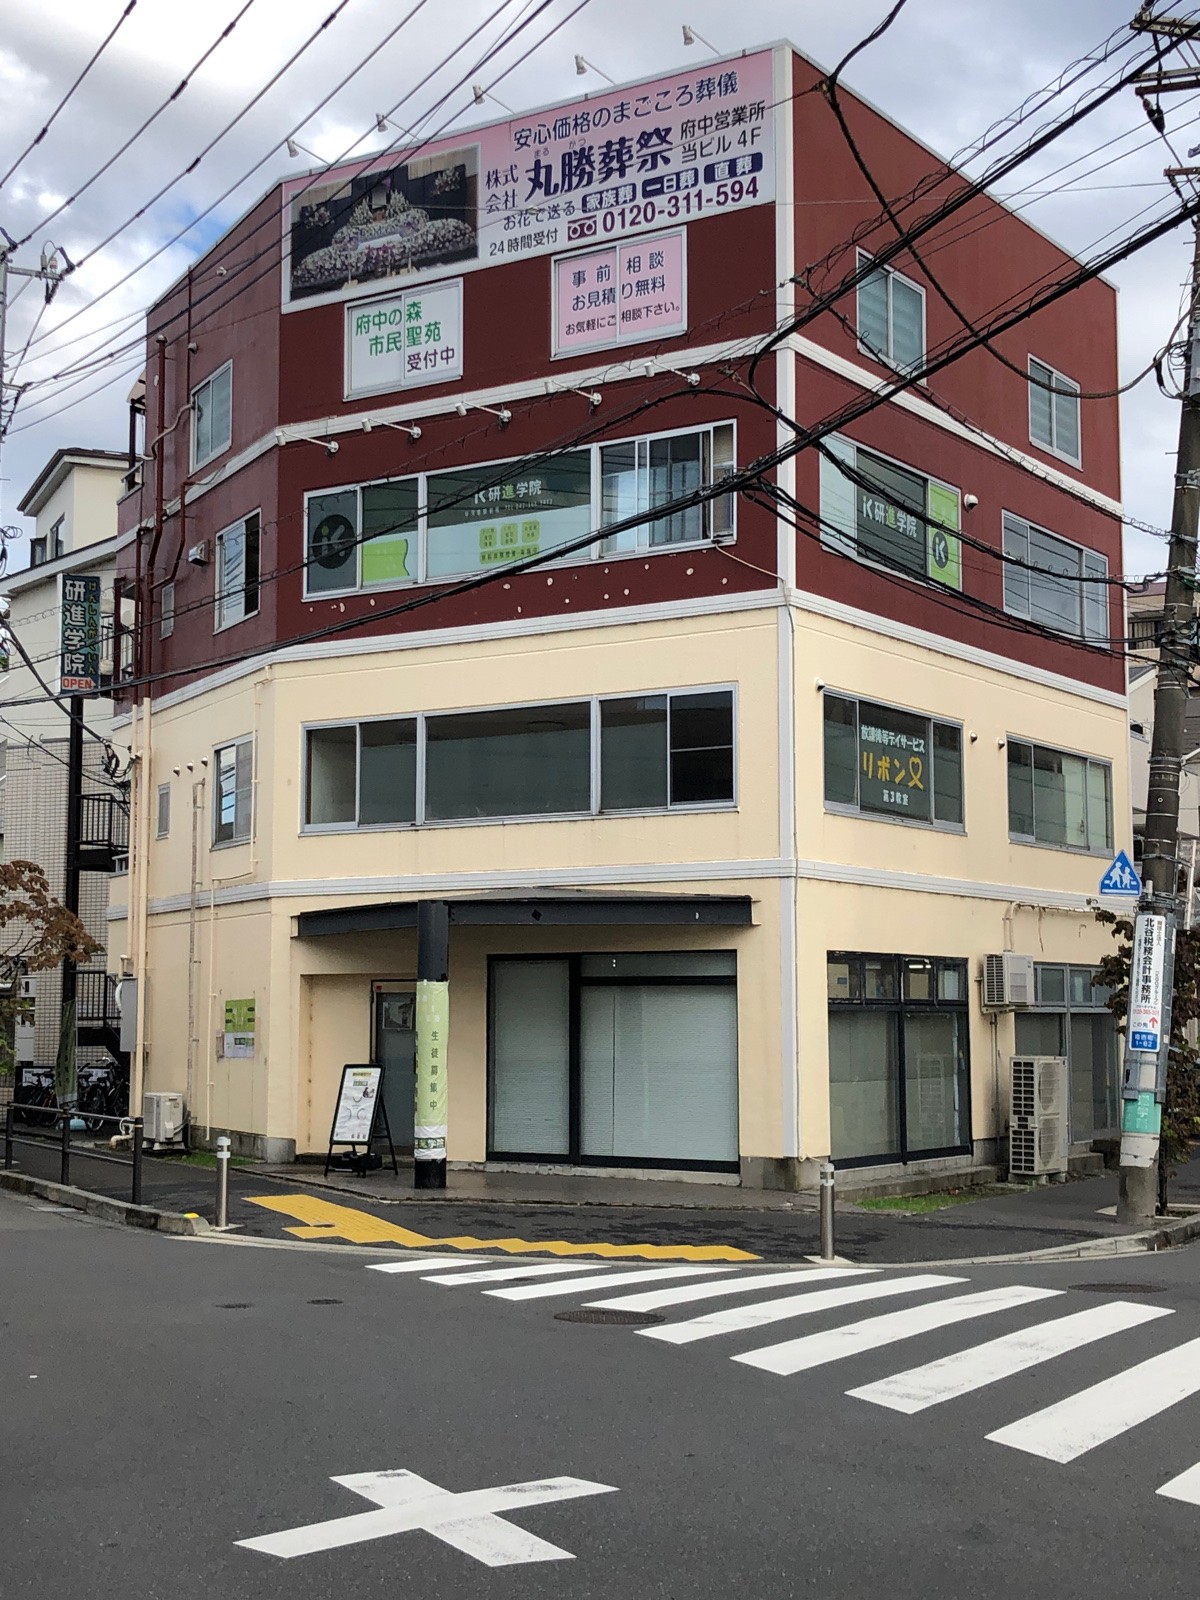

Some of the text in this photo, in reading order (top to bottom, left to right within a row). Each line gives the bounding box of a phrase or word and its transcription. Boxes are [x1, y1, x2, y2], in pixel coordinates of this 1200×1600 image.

[514, 71, 738, 152] 安心価格のまごころ葬儀
[680, 100, 766, 141] 府中営業所
[681, 126, 762, 164] 当ビル 4F
[486, 164, 519, 190] 株式
[524, 127, 673, 202] 丸勝葬祭
[486, 189, 518, 214] 会社
[503, 155, 752, 232] お花で送る 家族葬 一日葬 直葬
[602, 175, 759, 234] 0120-311-594
[490, 227, 558, 257] 24時間受付
[572, 251, 664, 289] 事前相談
[572, 274, 666, 312] お見積り無料
[355, 301, 422, 336] 府中の森
[369, 321, 442, 357] 市民聖苑
[407, 346, 455, 373] 受付中
[64, 580, 86, 675] 研進学院
[88, 581, 97, 675] けんしんがくいん
[62, 678, 93, 689] OPEN
[861, 724, 925, 754] 放課後等デイサービス
[863, 751, 906, 785] リボン
[1141, 917, 1154, 1004] 北谷税務会計事務所
[430, 1031, 440, 1111] 生徒募集中
